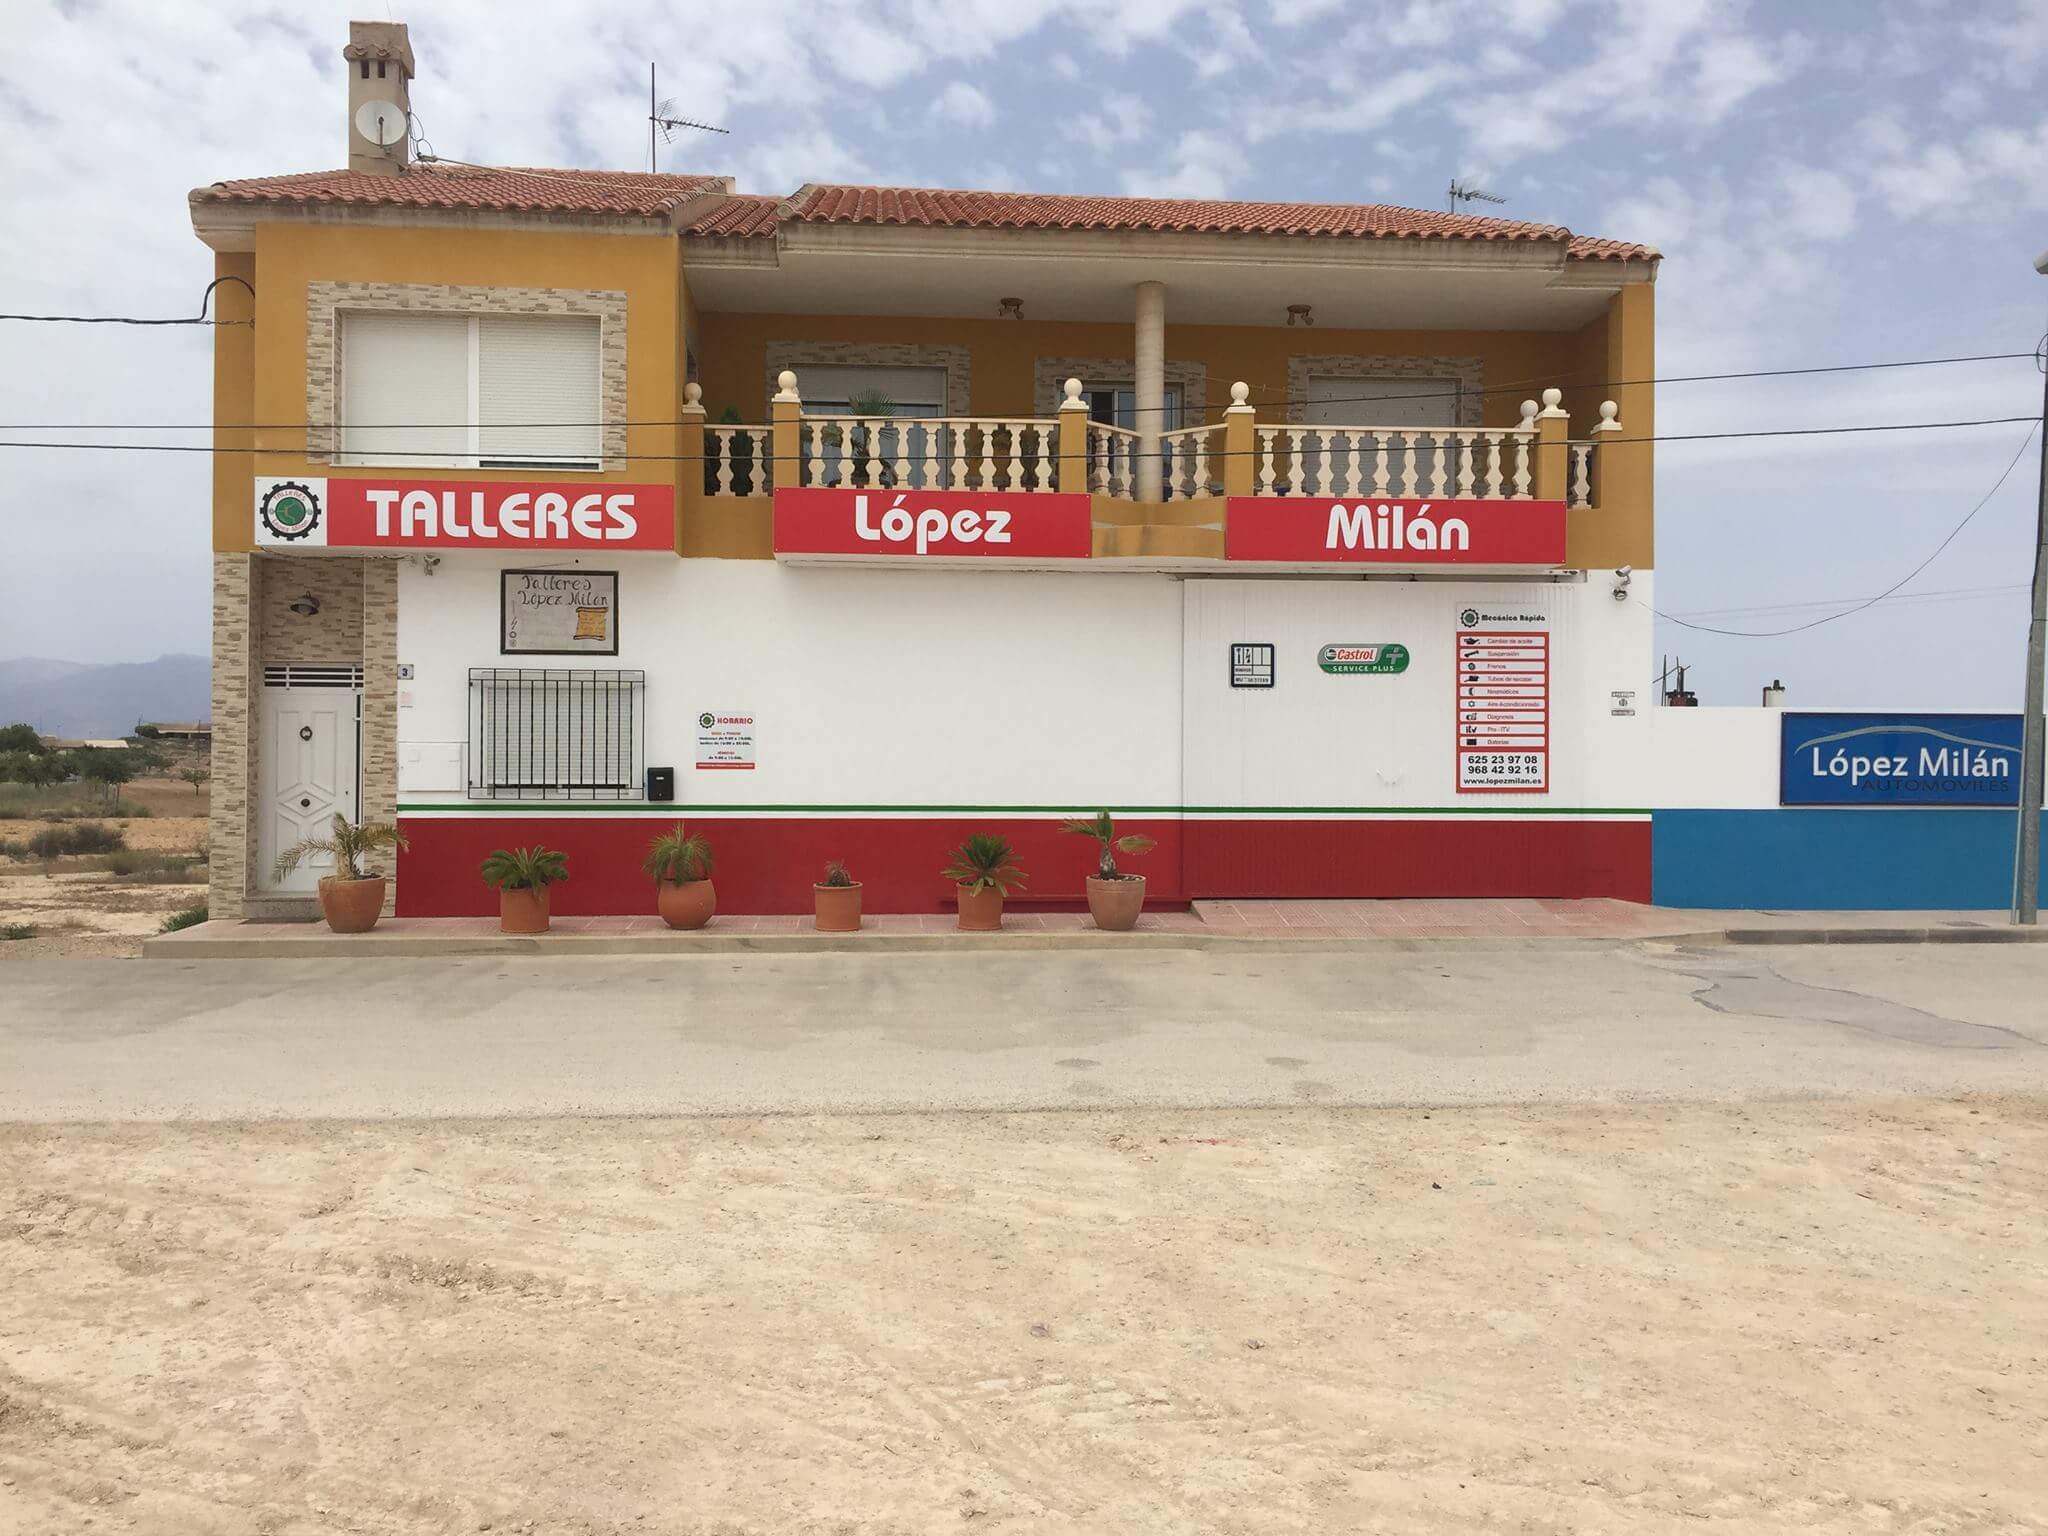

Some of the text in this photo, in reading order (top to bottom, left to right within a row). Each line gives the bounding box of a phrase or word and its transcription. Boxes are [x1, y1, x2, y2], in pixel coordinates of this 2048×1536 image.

[366, 489, 638, 540] TALLERES
[855, 494, 1011, 555] López
[1325, 504, 1470, 550] Milán
[521, 575, 592, 591] Talleres
[1337, 648, 1374, 660] Castrol
[402, 667, 409, 677] 3
[717, 717, 753, 725] HORARIO
[1468, 755, 1538, 764] 625 23 97 08
[1468, 765, 1538, 775] 968 42 92 16
[1812, 747, 2010, 786] López Milán
[1463, 777, 1542, 786] www.lopezmilan.es
